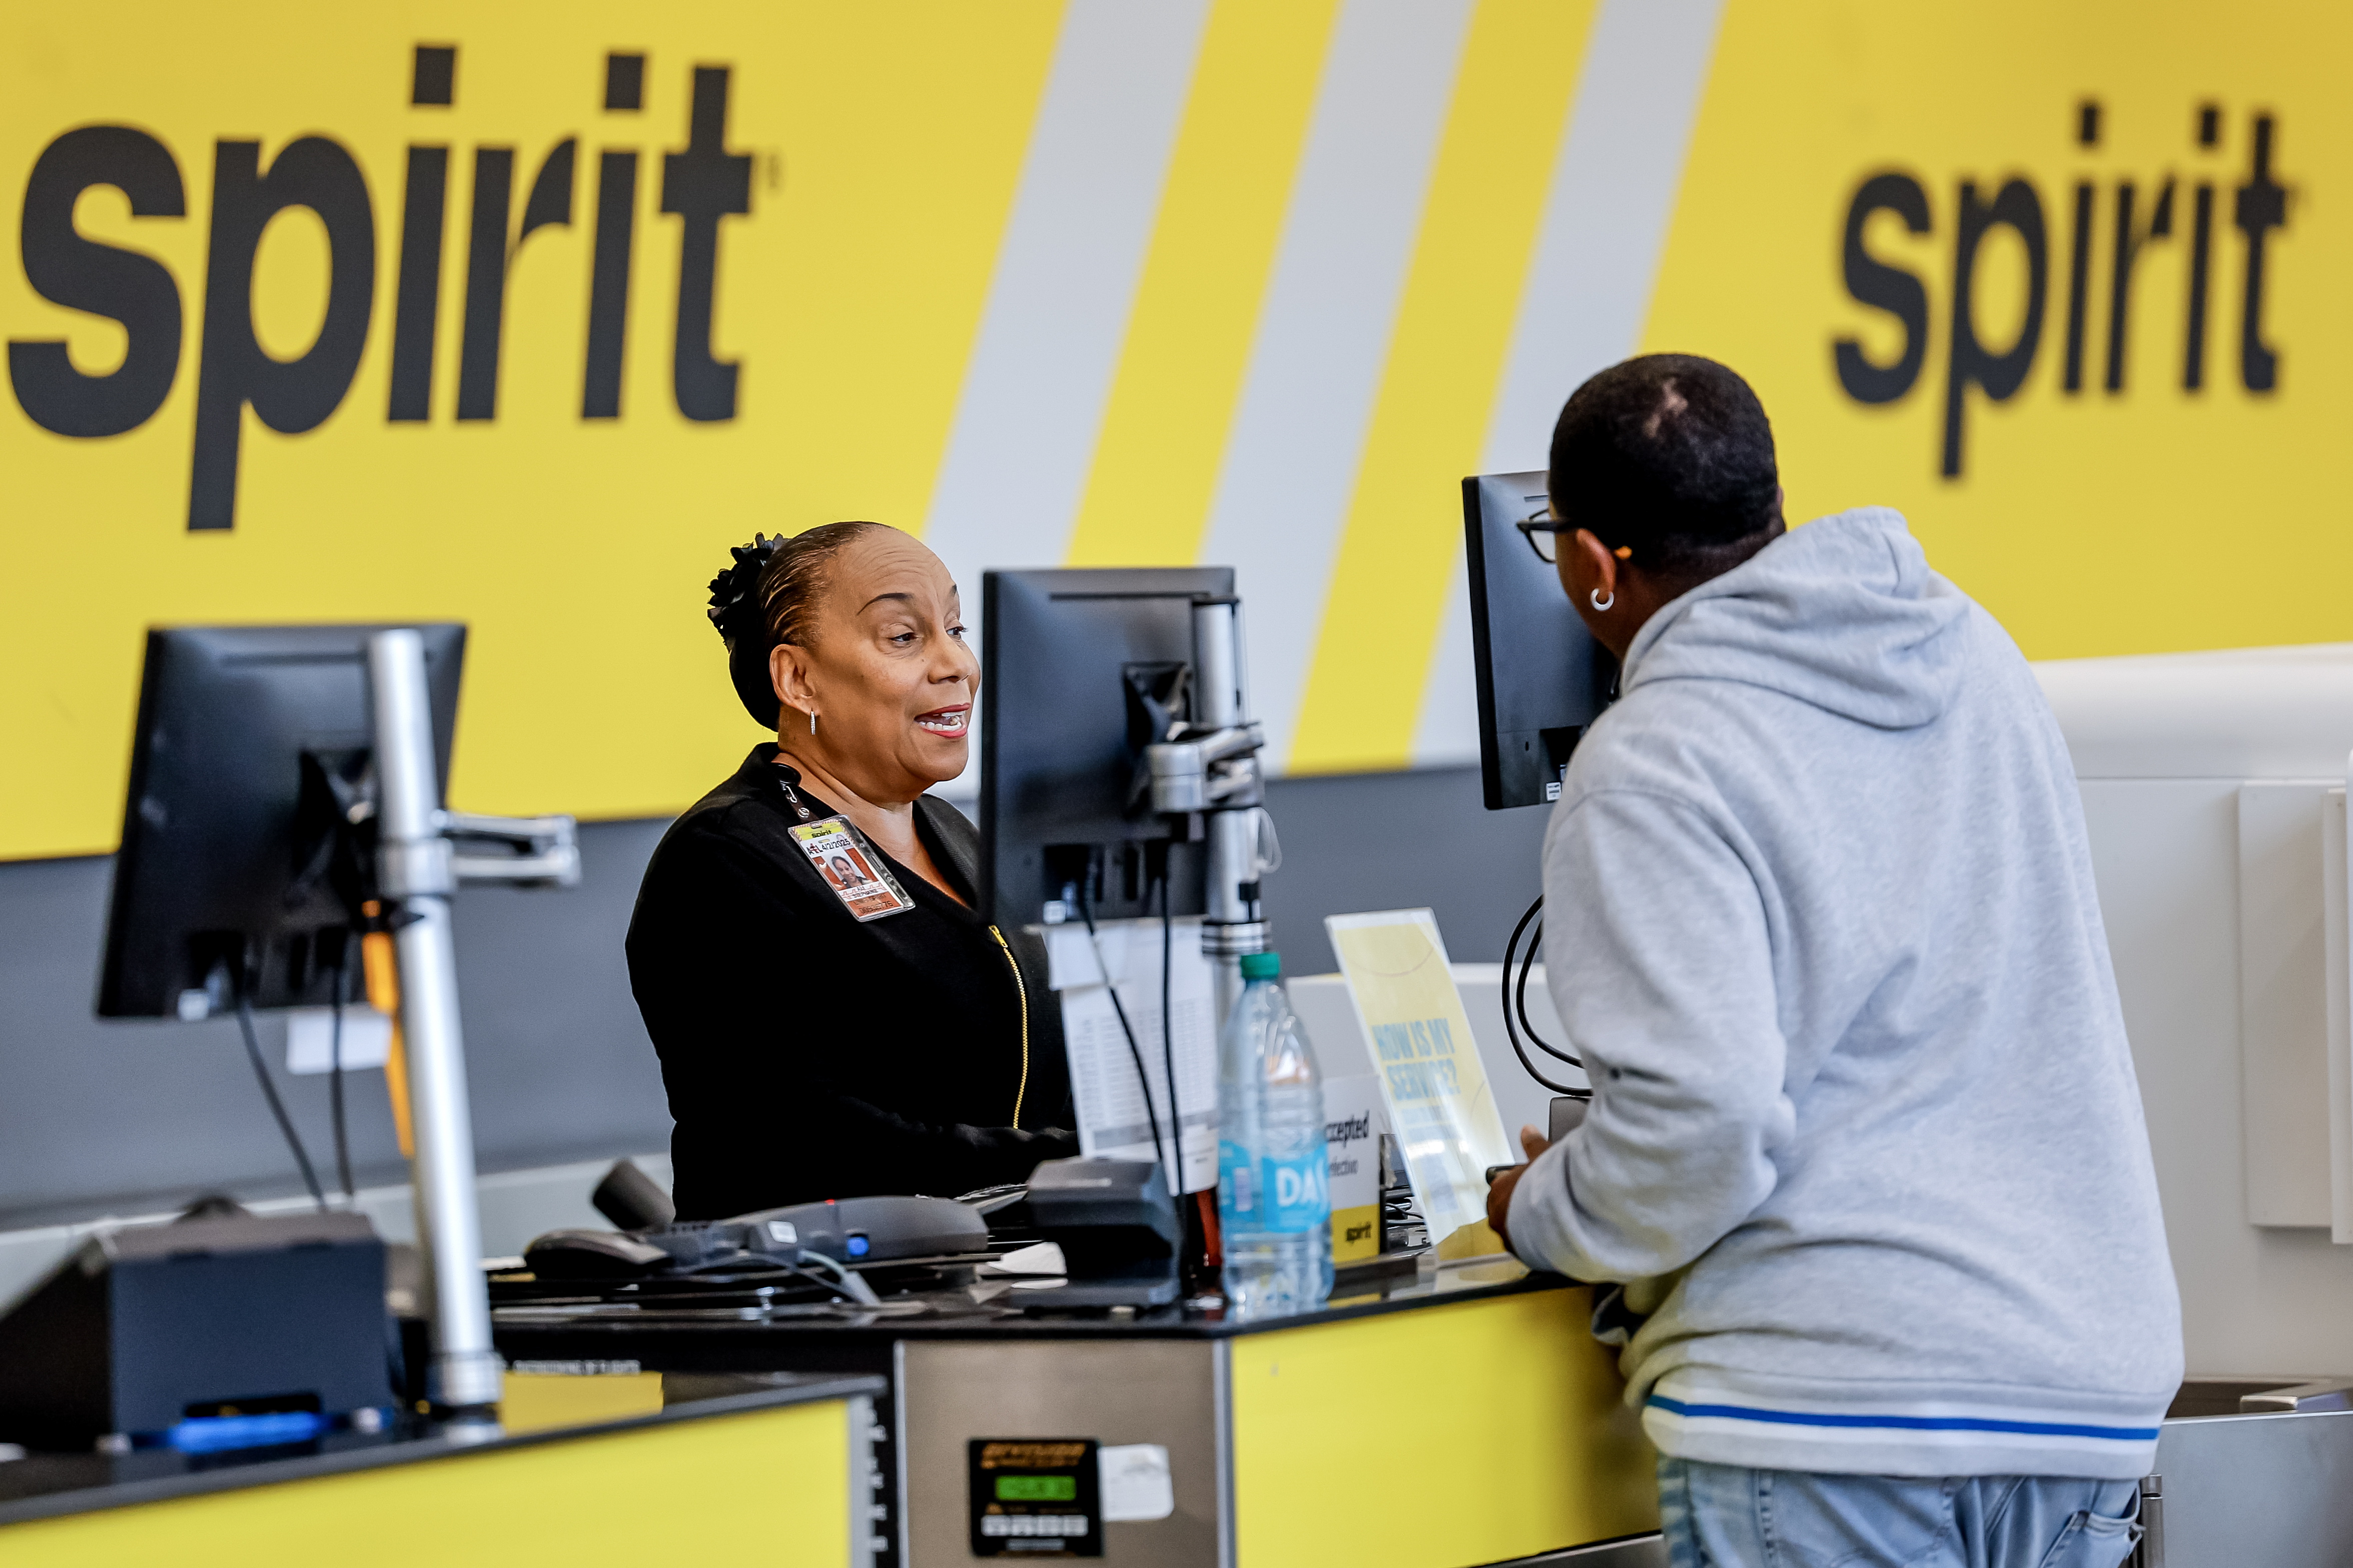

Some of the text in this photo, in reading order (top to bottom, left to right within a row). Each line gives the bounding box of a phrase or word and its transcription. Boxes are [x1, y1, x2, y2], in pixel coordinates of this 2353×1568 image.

[7, 44, 754, 533] spirit
[1831, 103, 2289, 479] spirit
[812, 830, 832, 838] spirit
[822, 838, 851, 851] 4/2/2025
